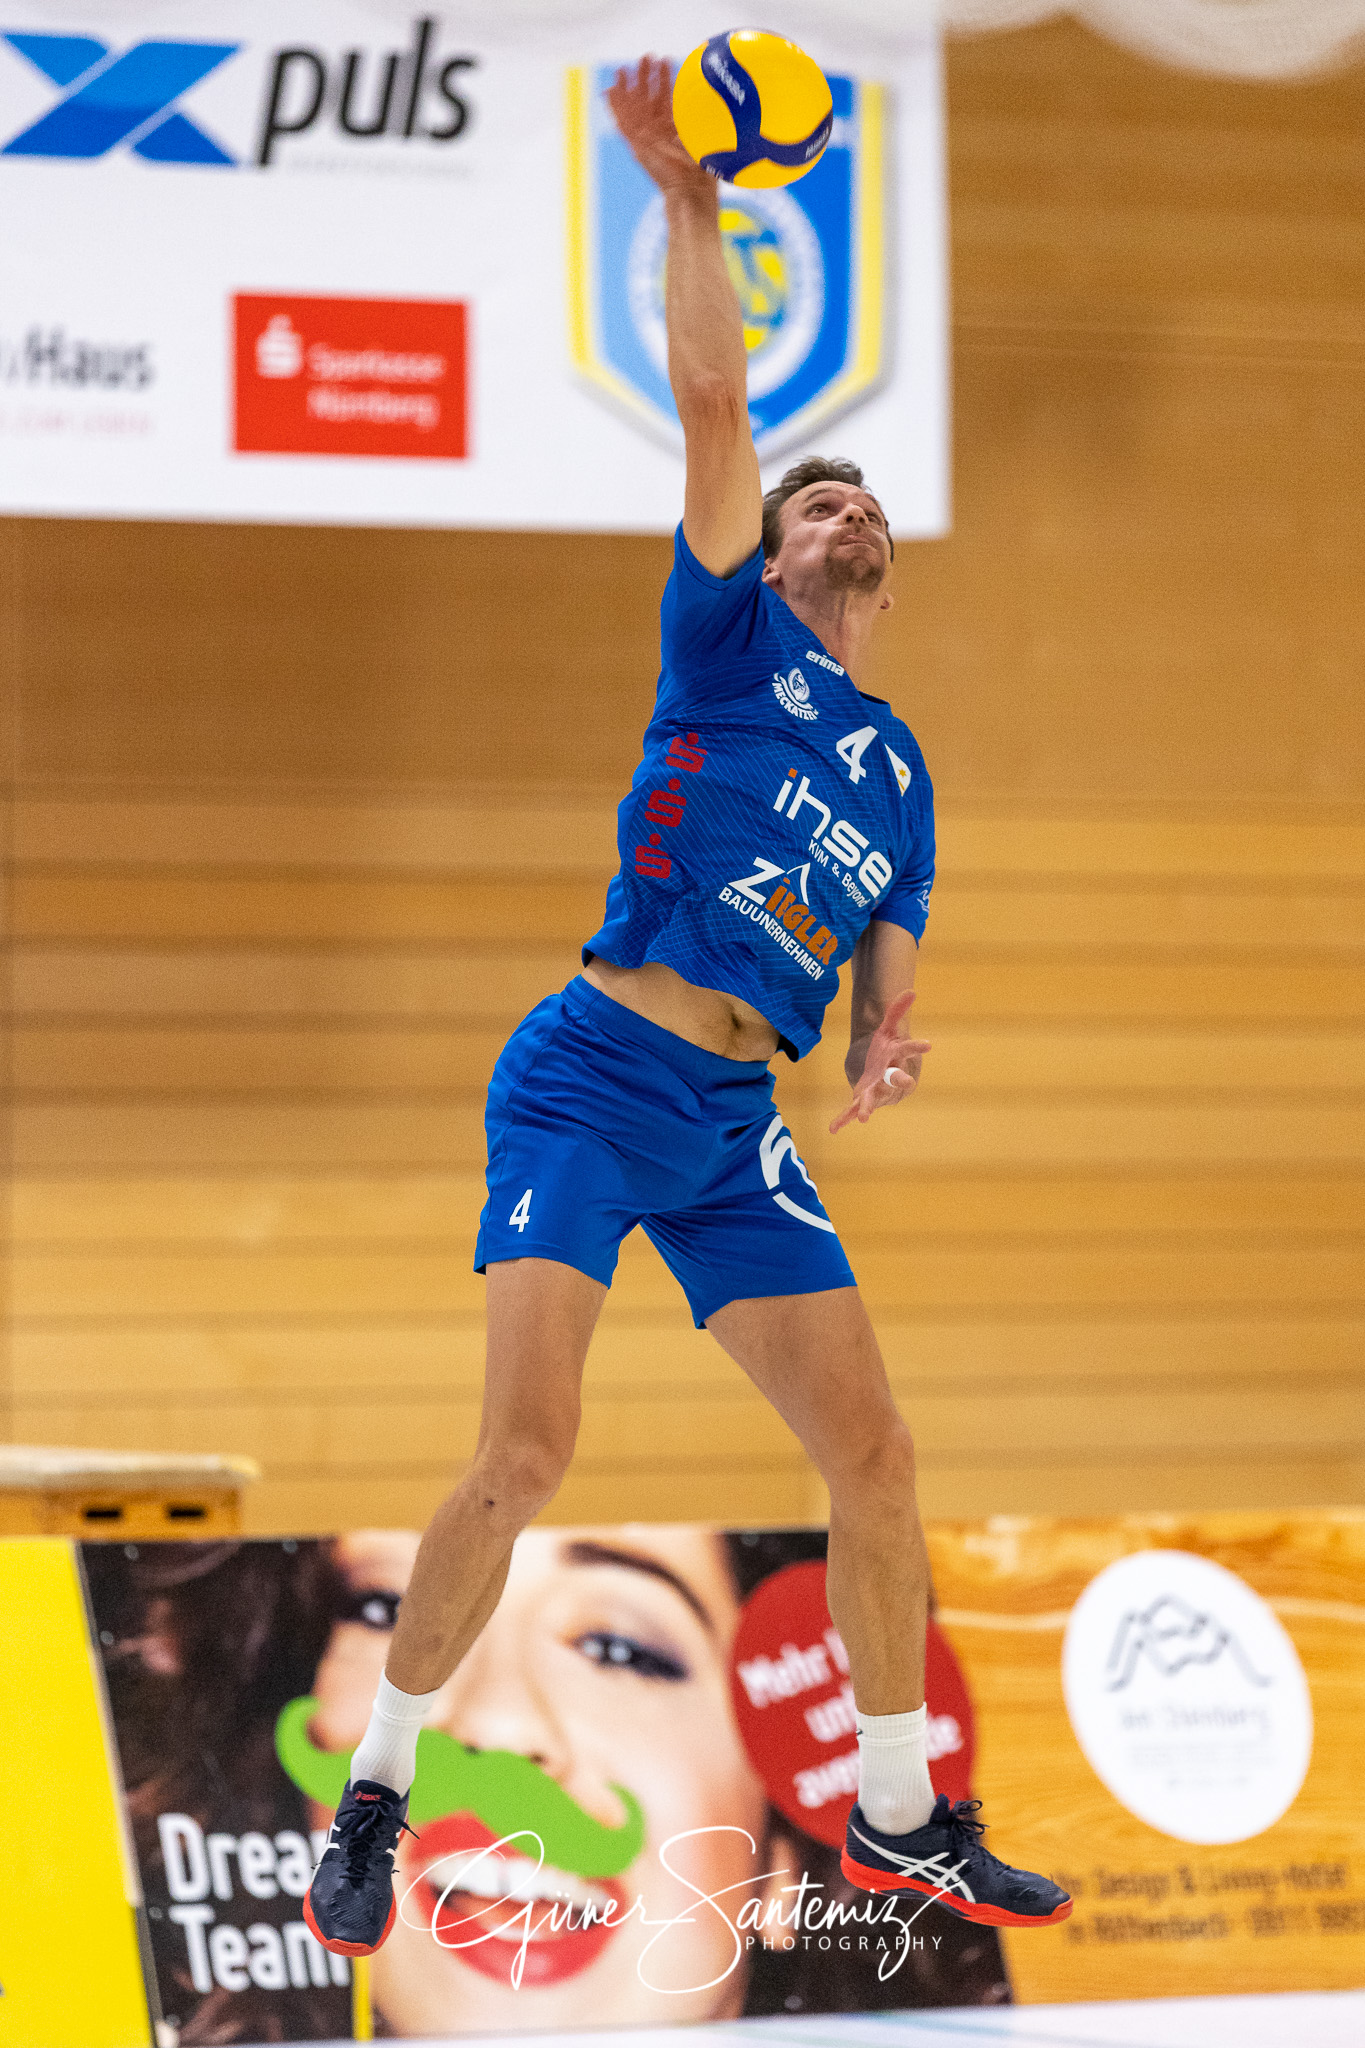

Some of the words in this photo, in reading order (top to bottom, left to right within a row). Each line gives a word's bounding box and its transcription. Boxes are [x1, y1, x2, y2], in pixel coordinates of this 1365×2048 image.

[258, 15, 477, 167] puls
[805, 650, 845, 677] erima
[836, 725, 879, 785] 4
[773, 767, 893, 899] ihse
[808, 838, 830, 868] KVM
[831, 862, 841, 878] &
[841, 872, 871, 909] Beyond
[508, 1188, 533, 1233] 4
[157, 1812, 329, 1902] Drea
